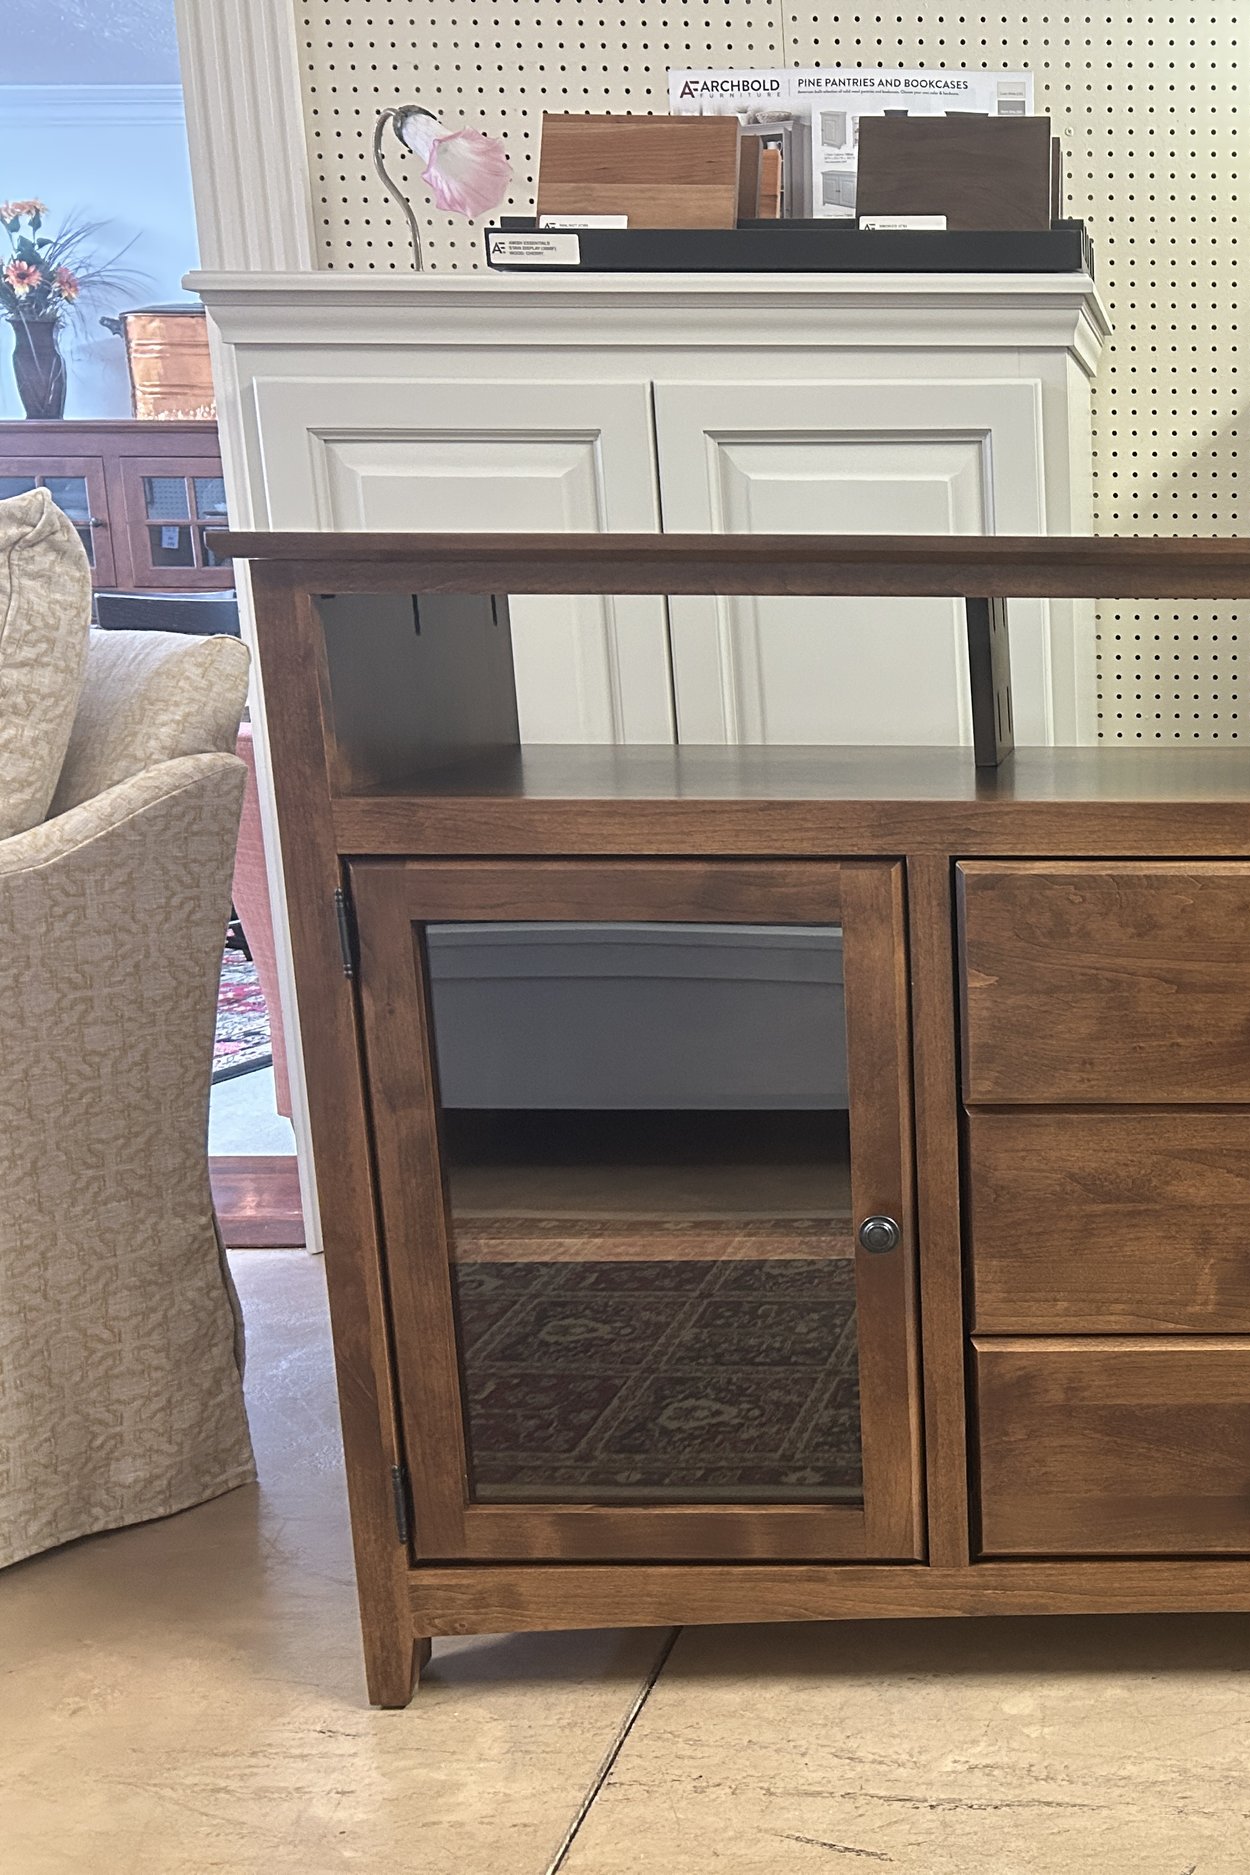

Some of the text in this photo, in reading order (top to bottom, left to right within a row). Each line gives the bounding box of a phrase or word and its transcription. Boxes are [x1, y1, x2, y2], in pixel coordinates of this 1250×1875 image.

[700, 79, 780, 92] ARCHBOLD
[798, 79, 968, 89] PINE PANTRIES AND BOOKCASES
